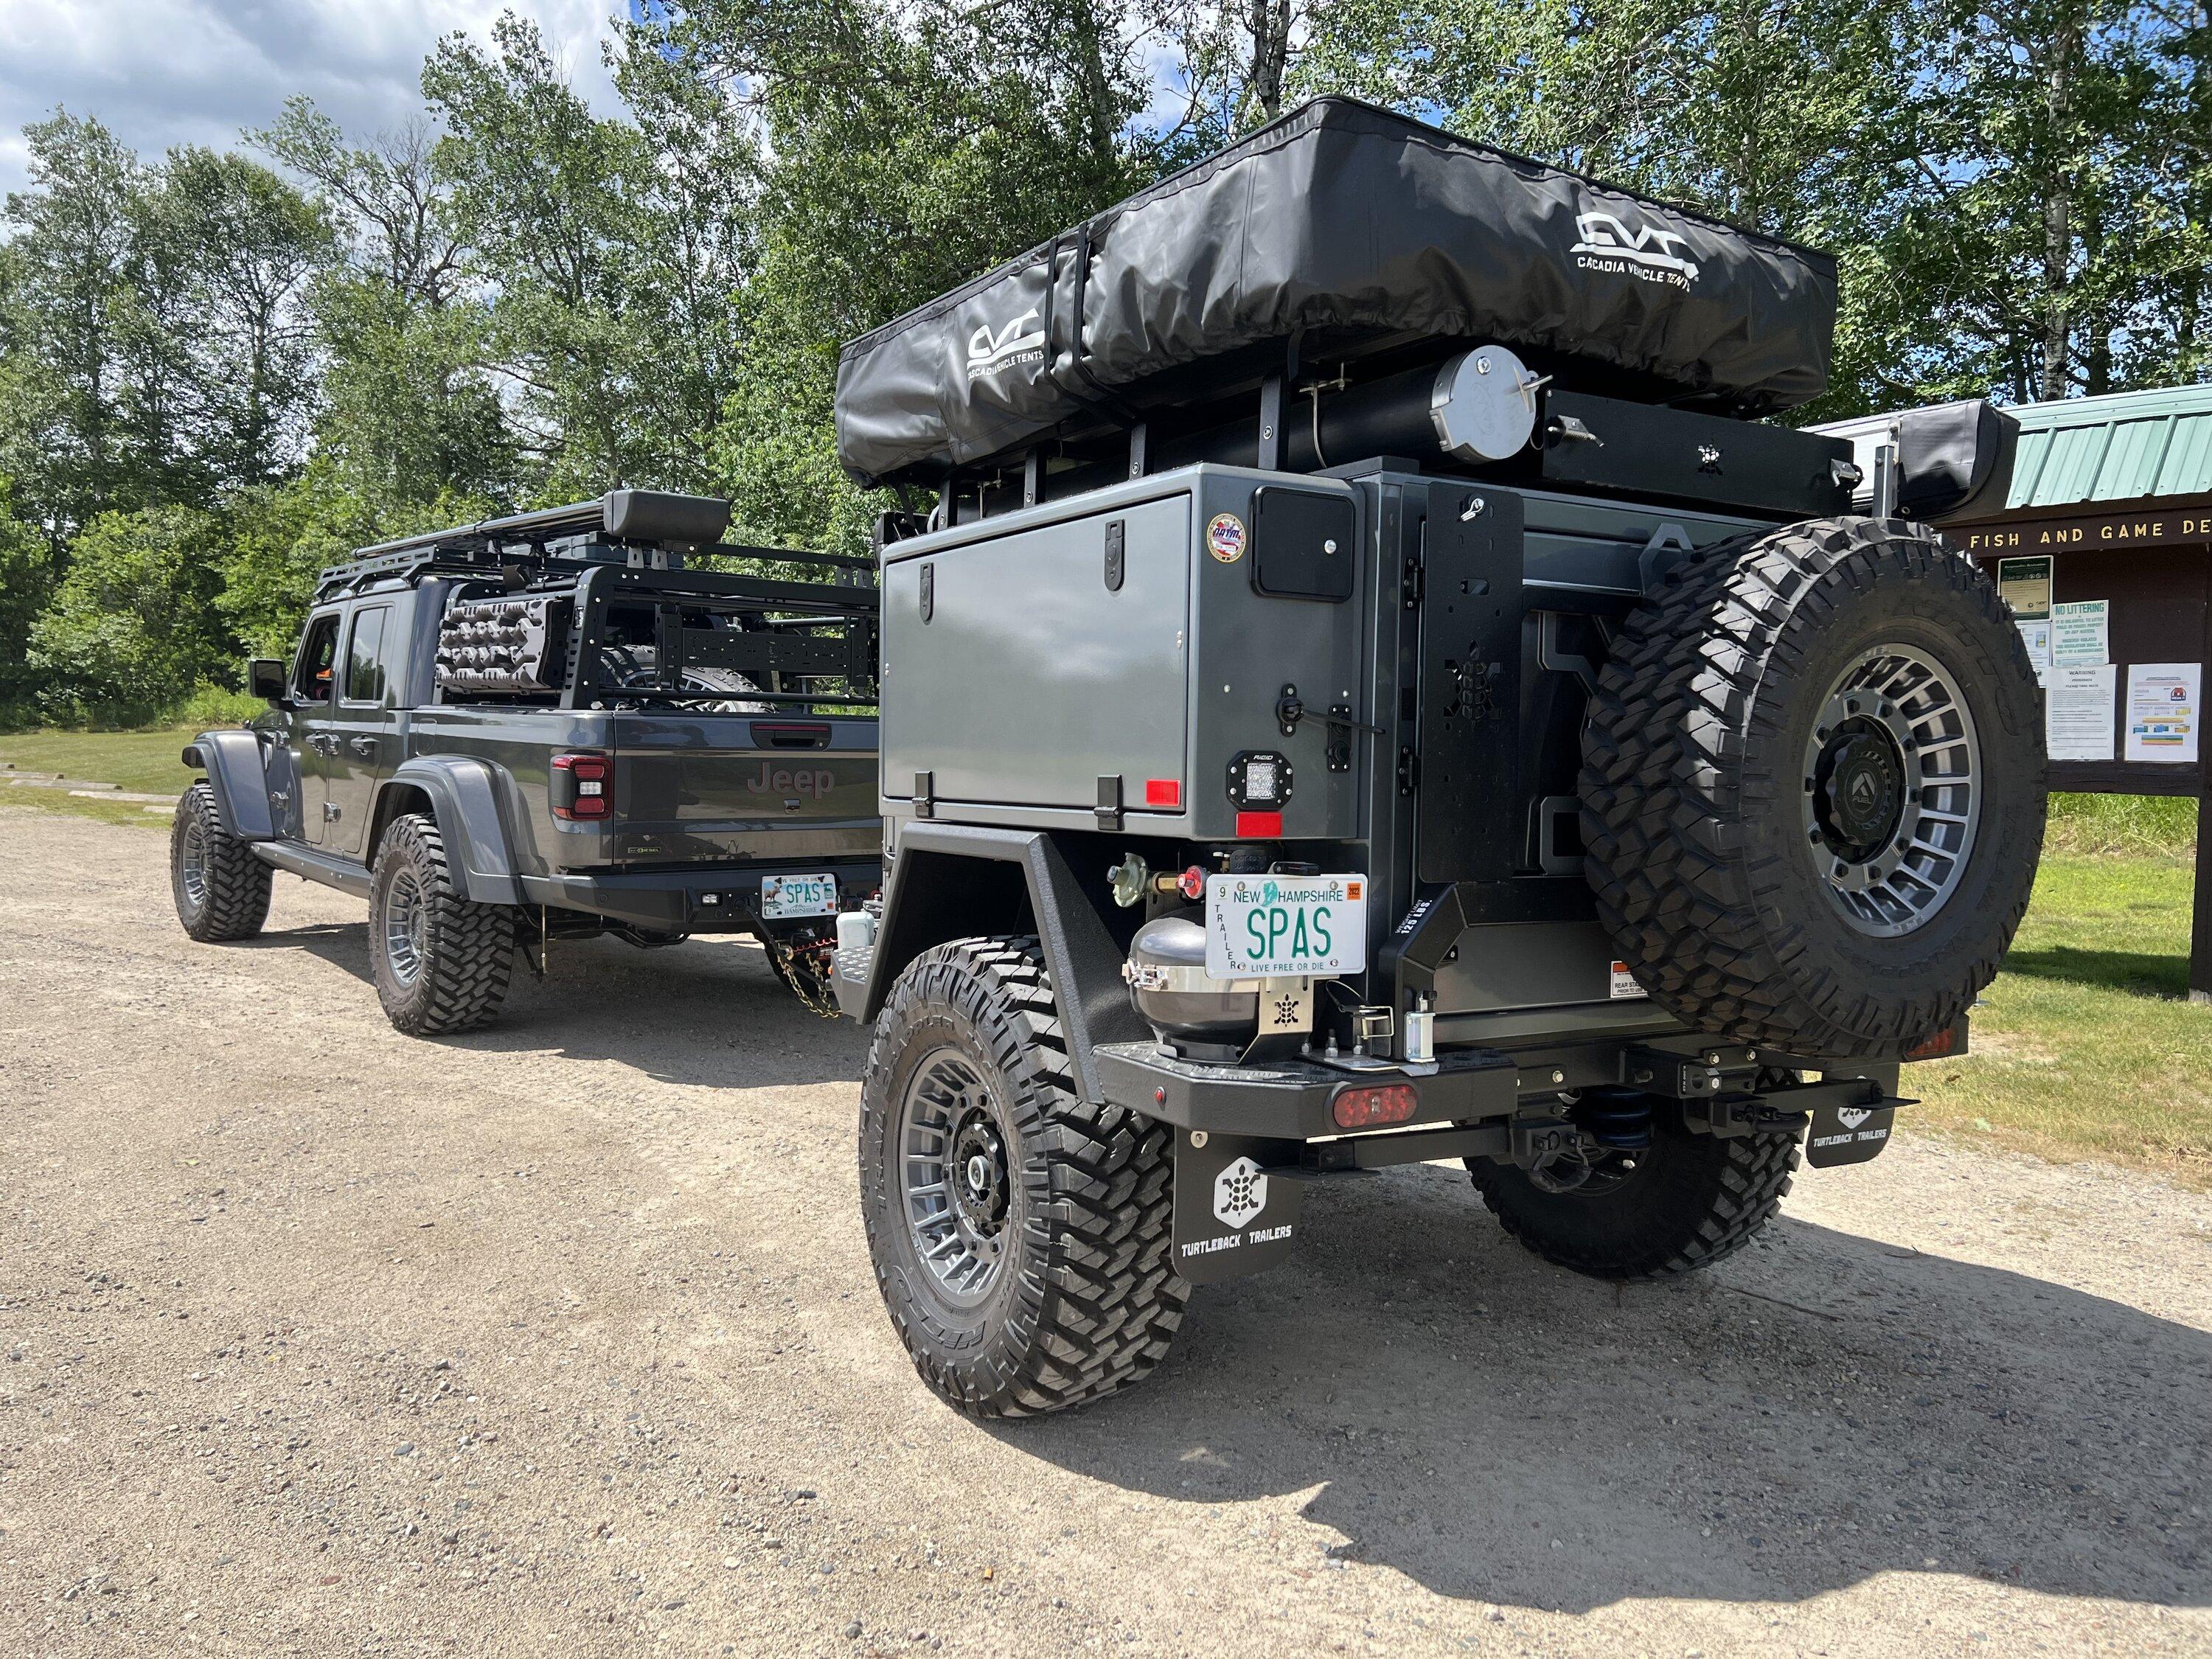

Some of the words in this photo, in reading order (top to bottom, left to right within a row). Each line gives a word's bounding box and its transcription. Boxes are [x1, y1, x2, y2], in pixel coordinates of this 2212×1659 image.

[1577, 256, 1625, 273] CACADIA
[1627, 262, 1665, 282] VEHICLE
[1017, 350, 1044, 364] TENTS
[1969, 532, 2020, 549] FISH
[2040, 528, 2084, 545] AND
[2101, 522, 2163, 540] GAME
[2183, 519, 2212, 534] DE
[2055, 605, 2065, 616] NO
[2067, 602, 2104, 614] LITTERING
[746, 762, 835, 800] Jeep
[786, 883, 821, 904] SPAS
[1220, 886, 1226, 898] 9
[1234, 891, 1261, 903] NEW
[1278, 890, 1343, 902] HAMPSHIRE
[1246, 906, 1332, 959] SPAS
[1401, 919, 1418, 934] 125
[1214, 905, 1237, 969] TRAILER
[1251, 964, 1270, 973] LIVE
[1273, 963, 1293, 971] FREE
[1297, 962, 1308, 970] OR
[1814, 1133, 1853, 1147] TURTLEBACK
[1857, 1129, 1888, 1141] TRAILERS
[1181, 1234, 1241, 1257] TURTLEBACK
[1249, 1225, 1293, 1245] TRAILERS
